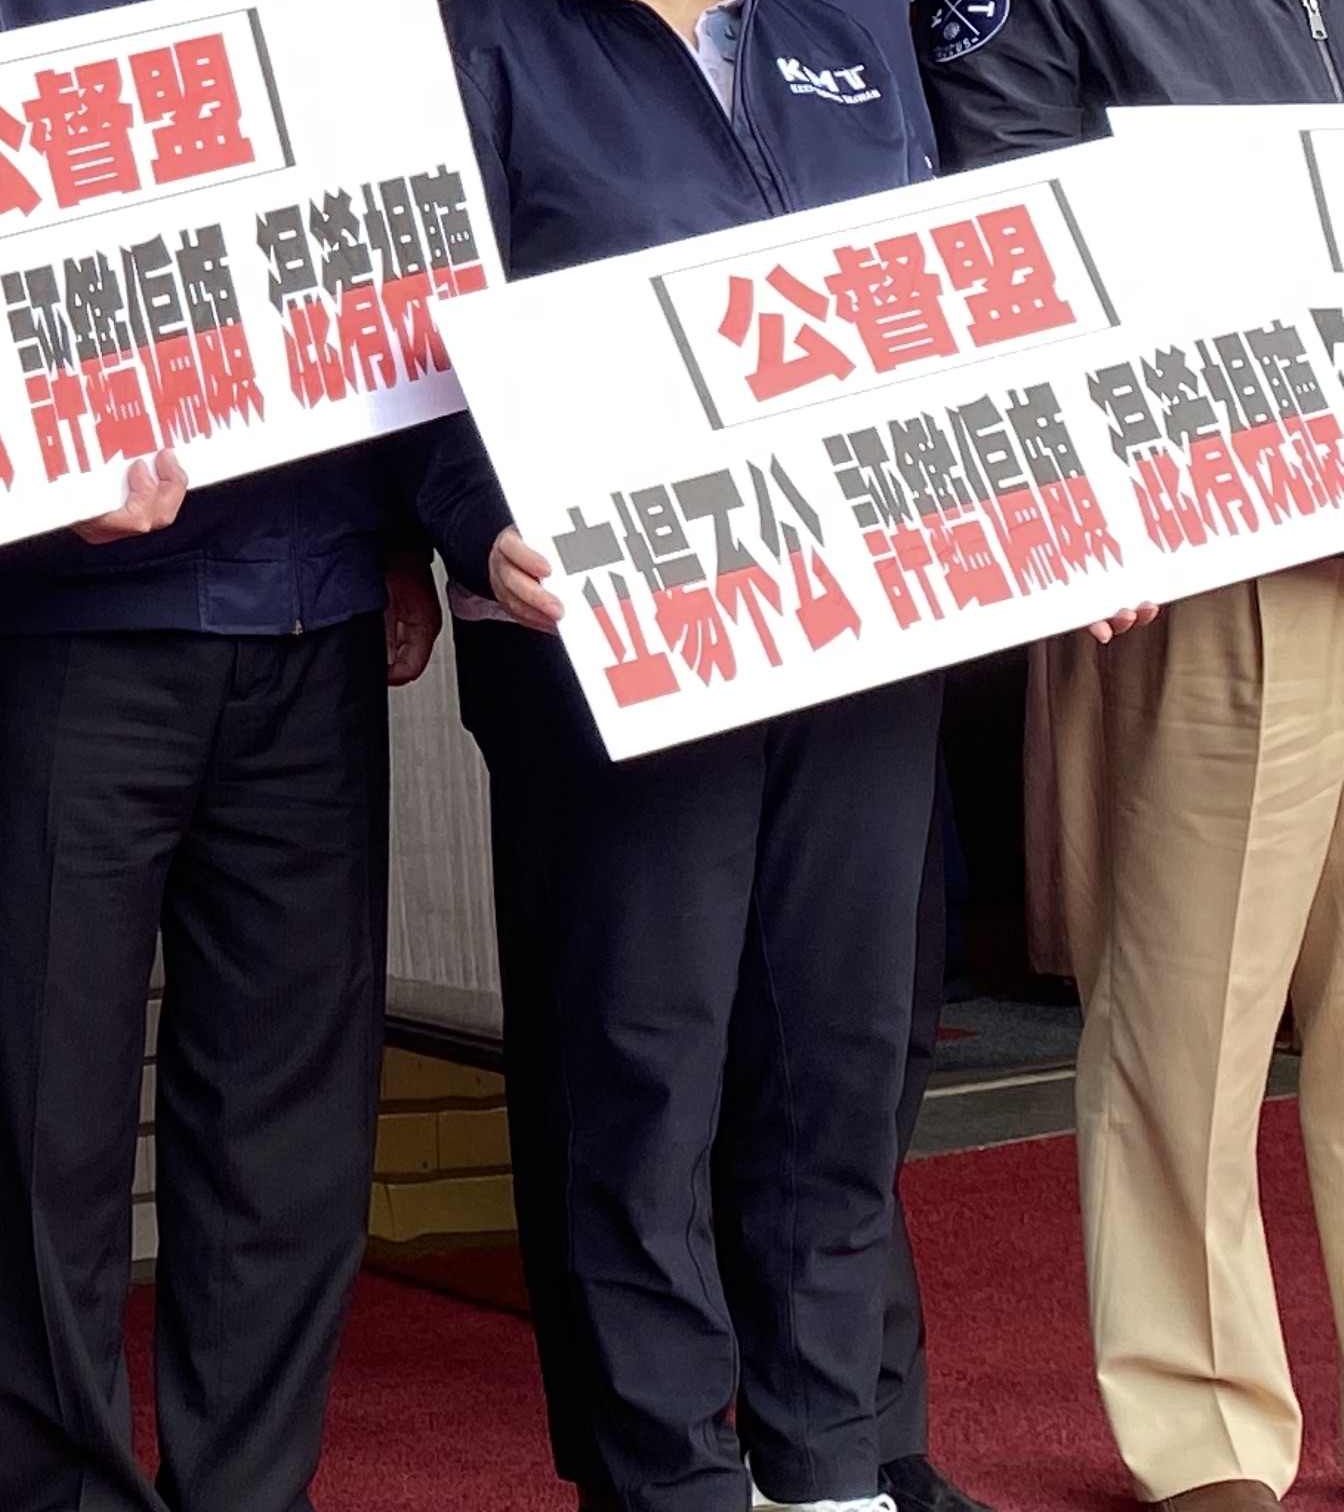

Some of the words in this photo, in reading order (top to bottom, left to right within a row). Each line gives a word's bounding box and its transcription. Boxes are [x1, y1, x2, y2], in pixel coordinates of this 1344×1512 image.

[776, 57, 866, 92] KMT
[0, 223, 265, 483] 評鑑偏頗
[718, 204, 1076, 403] 公督盟
[552, 454, 861, 709] 立場不公
[823, 381, 1124, 630] 評鑑偏頗
[1088, 319, 1344, 554] 混淆視聽
